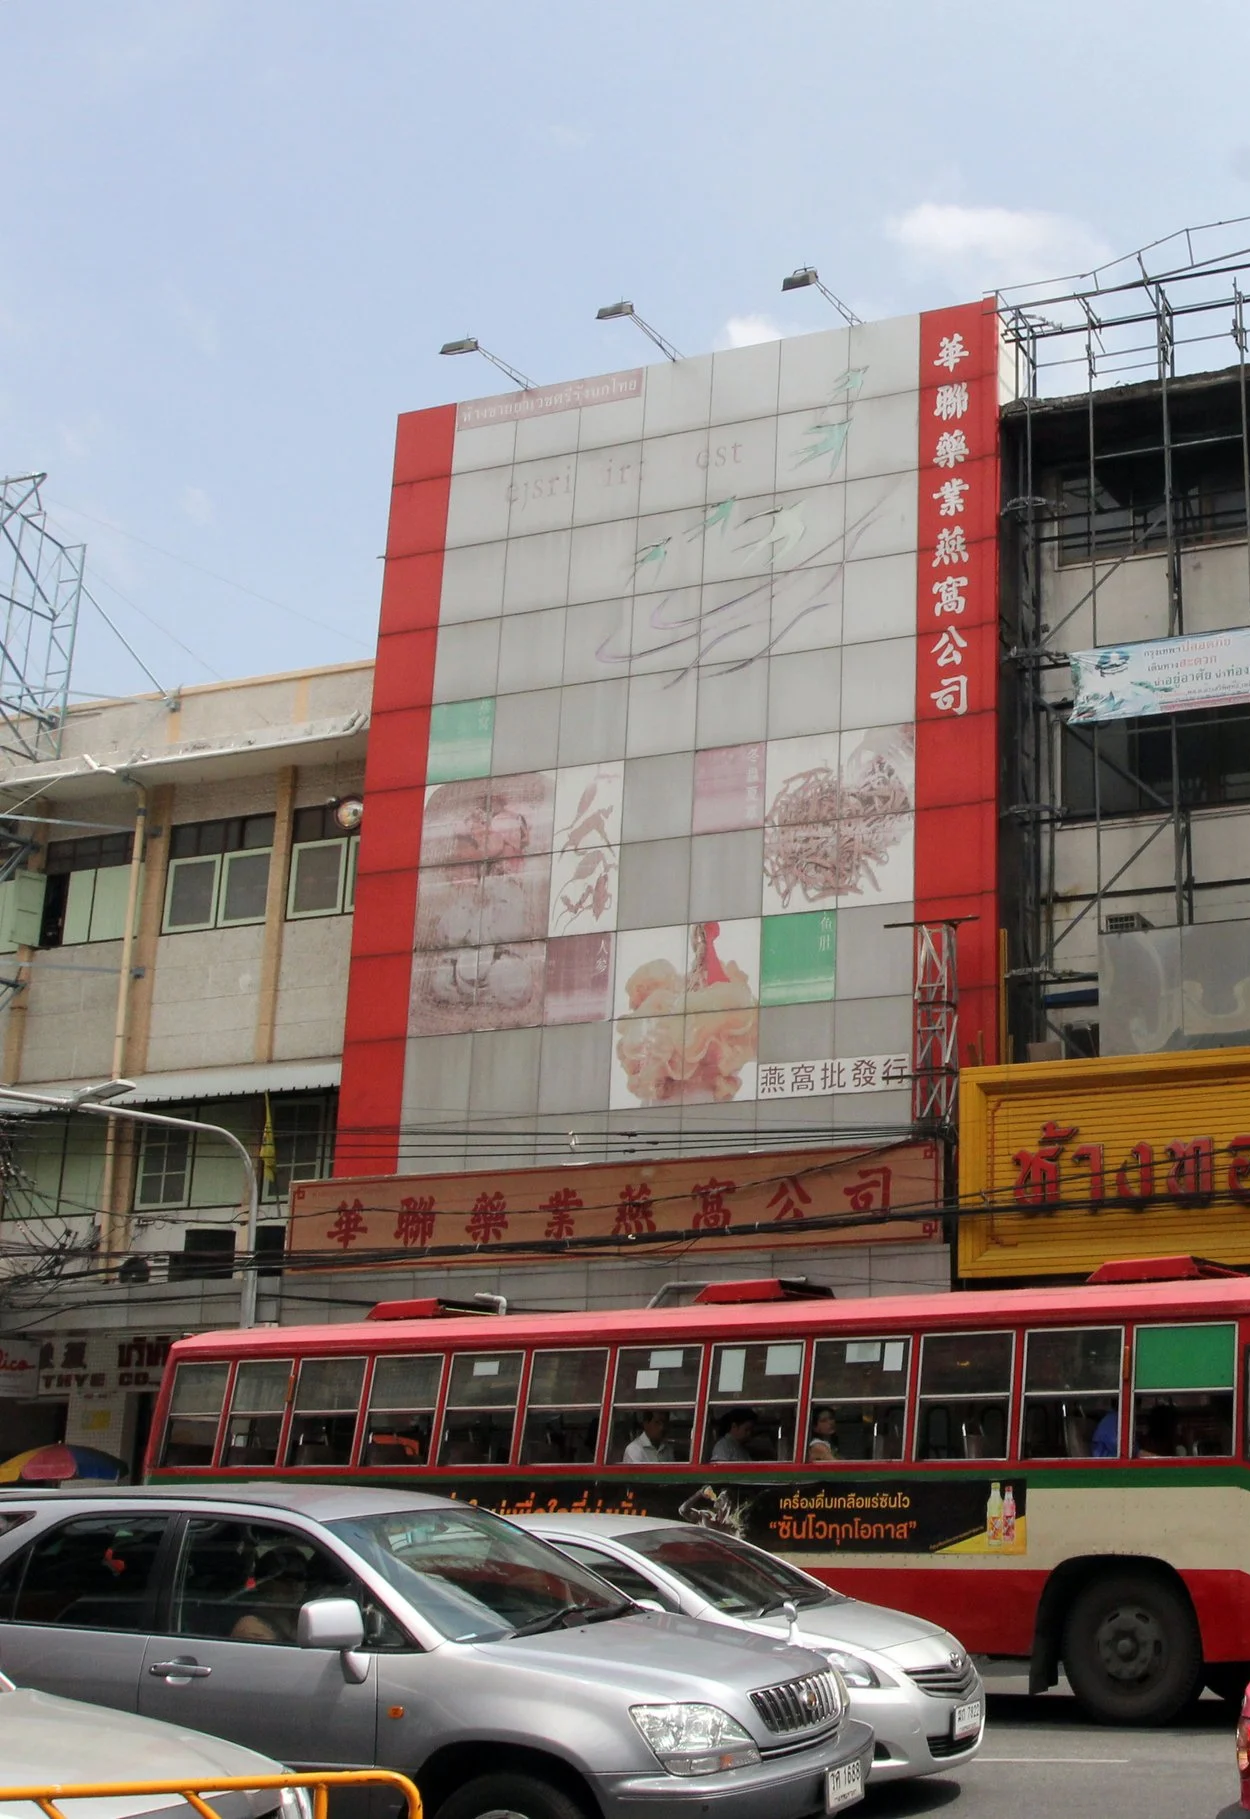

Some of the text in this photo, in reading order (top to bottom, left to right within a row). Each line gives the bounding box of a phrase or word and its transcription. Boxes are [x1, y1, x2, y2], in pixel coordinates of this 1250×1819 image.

[930, 333, 970, 717] 華聯藥業燕窩公司
[760, 1058, 908, 1094] 燕窩批發行
[327, 1166, 894, 1249] 華聯藥業燕窩公司
[779, 1489, 910, 1509] เครื่องดื่มเกลือแร่ซันโว
